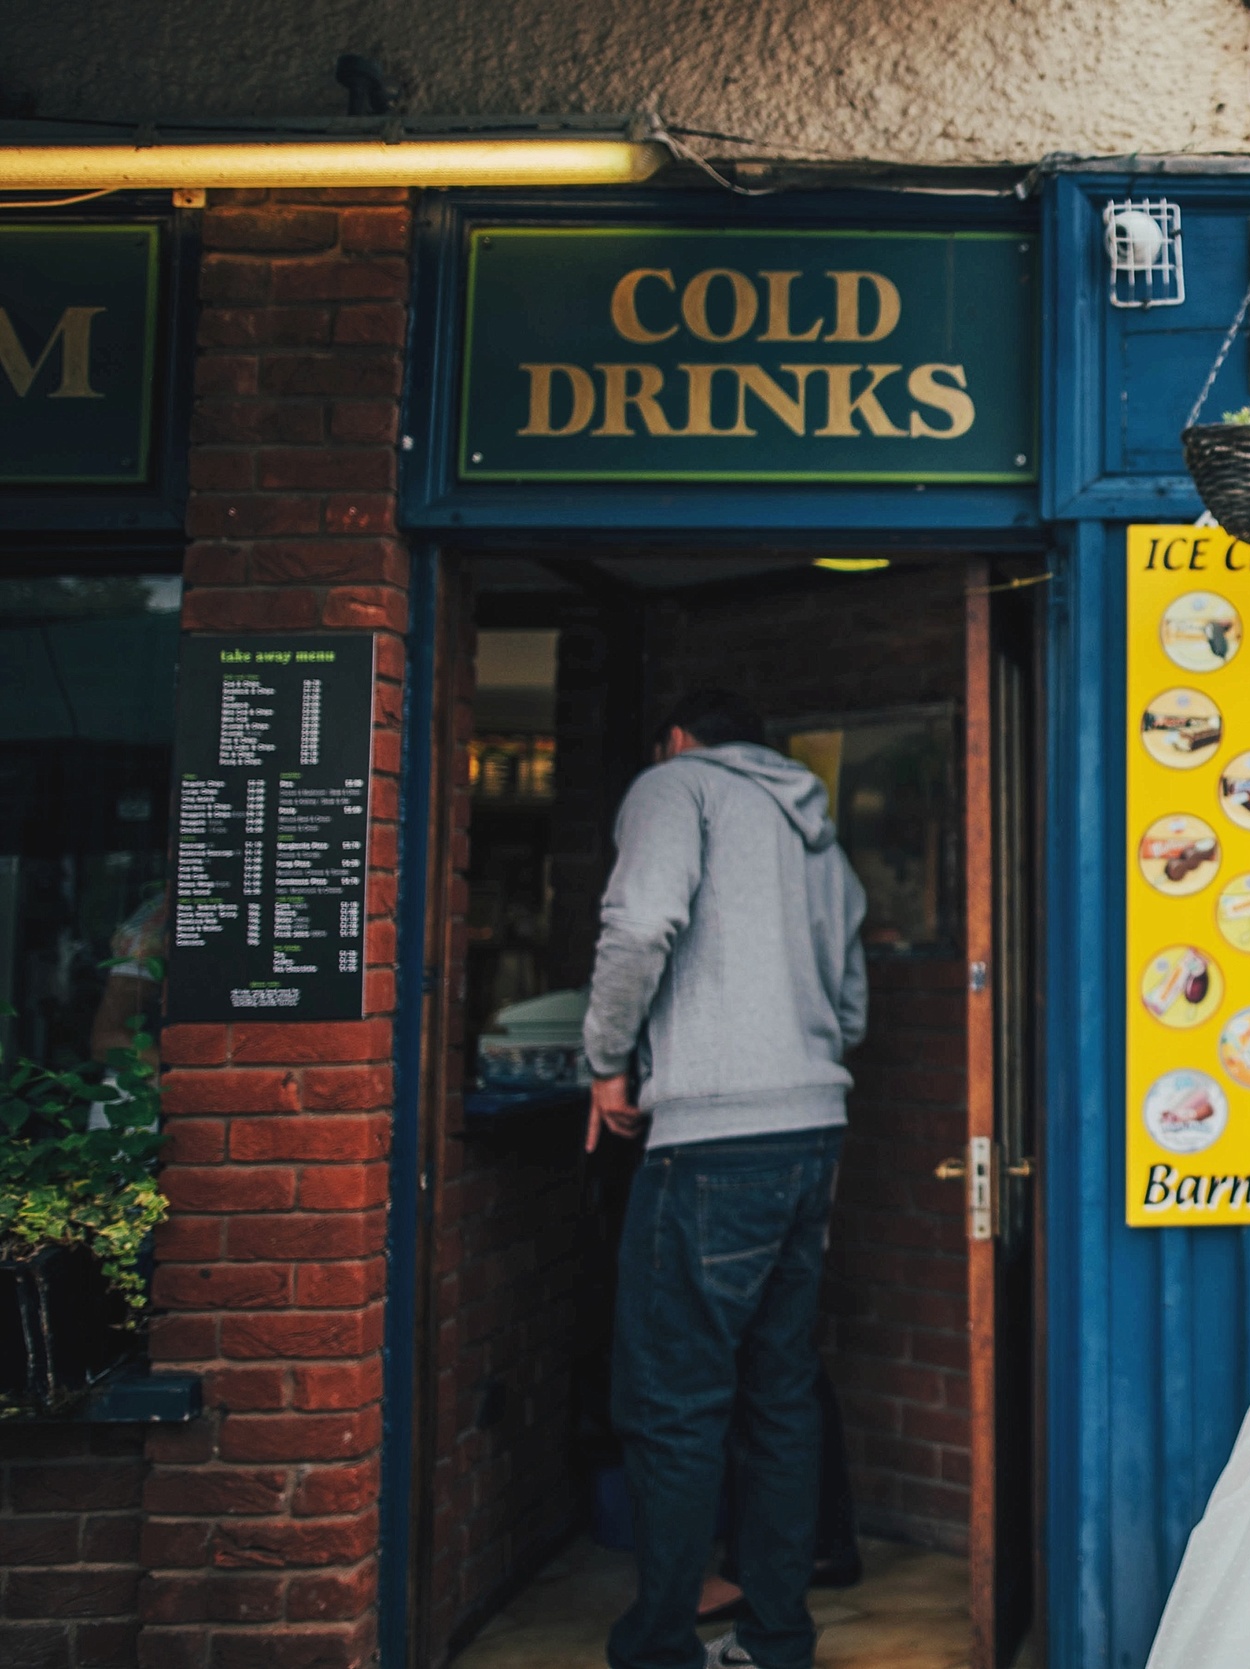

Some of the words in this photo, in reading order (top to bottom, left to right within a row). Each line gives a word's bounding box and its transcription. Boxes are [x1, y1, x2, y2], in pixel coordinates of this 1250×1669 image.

[611, 268, 902, 344] COLD
[0, 306, 108, 399] M
[517, 363, 975, 440] DRINKS
[1143, 537, 1212, 571] ICE
[219, 648, 252, 663] take
[255, 649, 292, 665] away
[295, 649, 336, 663] menu
